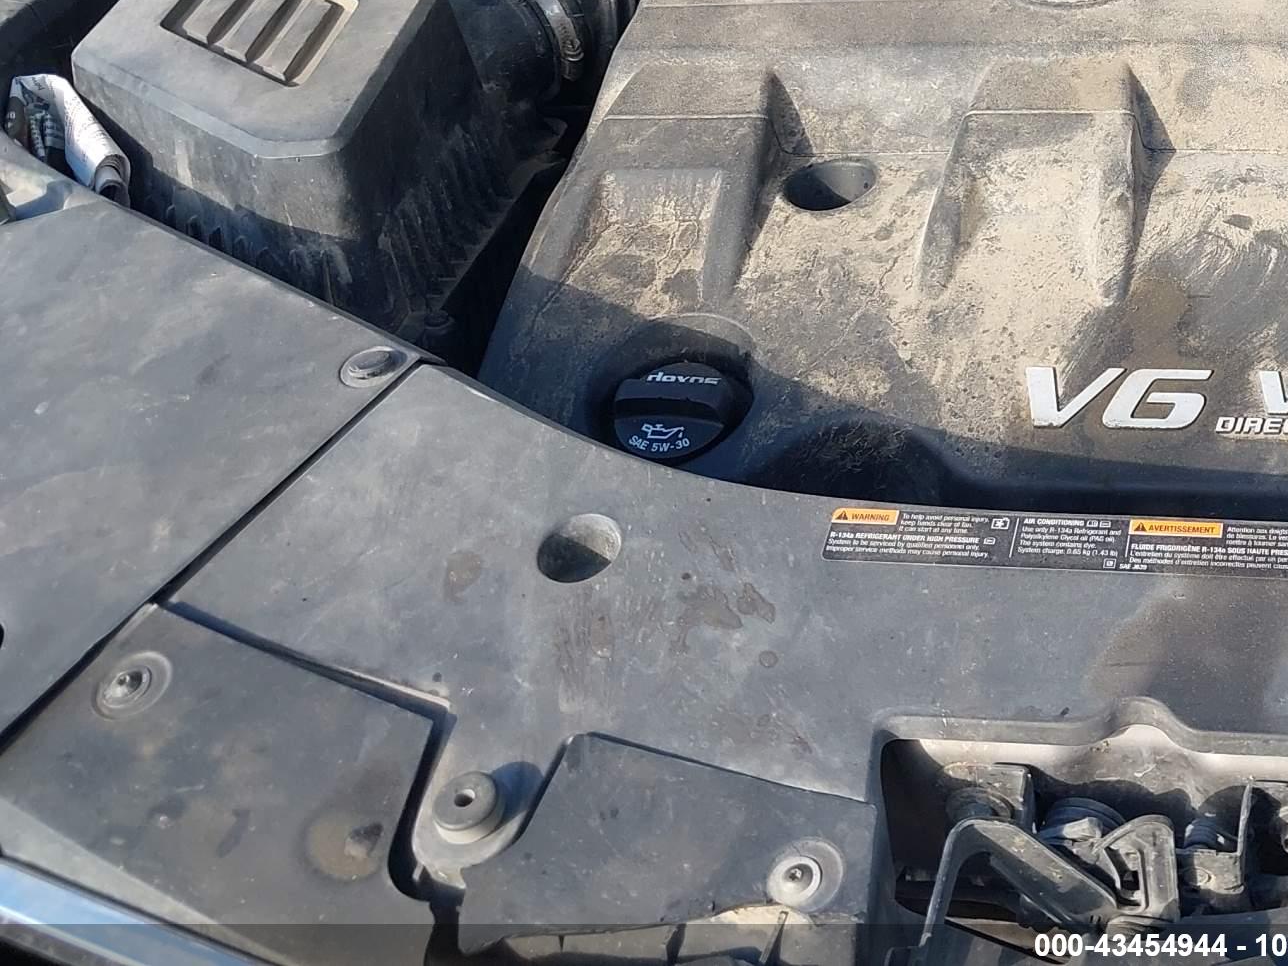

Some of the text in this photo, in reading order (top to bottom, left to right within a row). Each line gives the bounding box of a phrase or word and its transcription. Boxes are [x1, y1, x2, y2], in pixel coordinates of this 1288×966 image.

[1025, 366, 1213, 428] V6
[629, 435, 690, 452] SAE 5W-30
[852, 514, 890, 522] WARNING
[1148, 524, 1215, 533] AVERTISSEMENT
[1156, 544, 1200, 552] FRIGORIGÈNE
